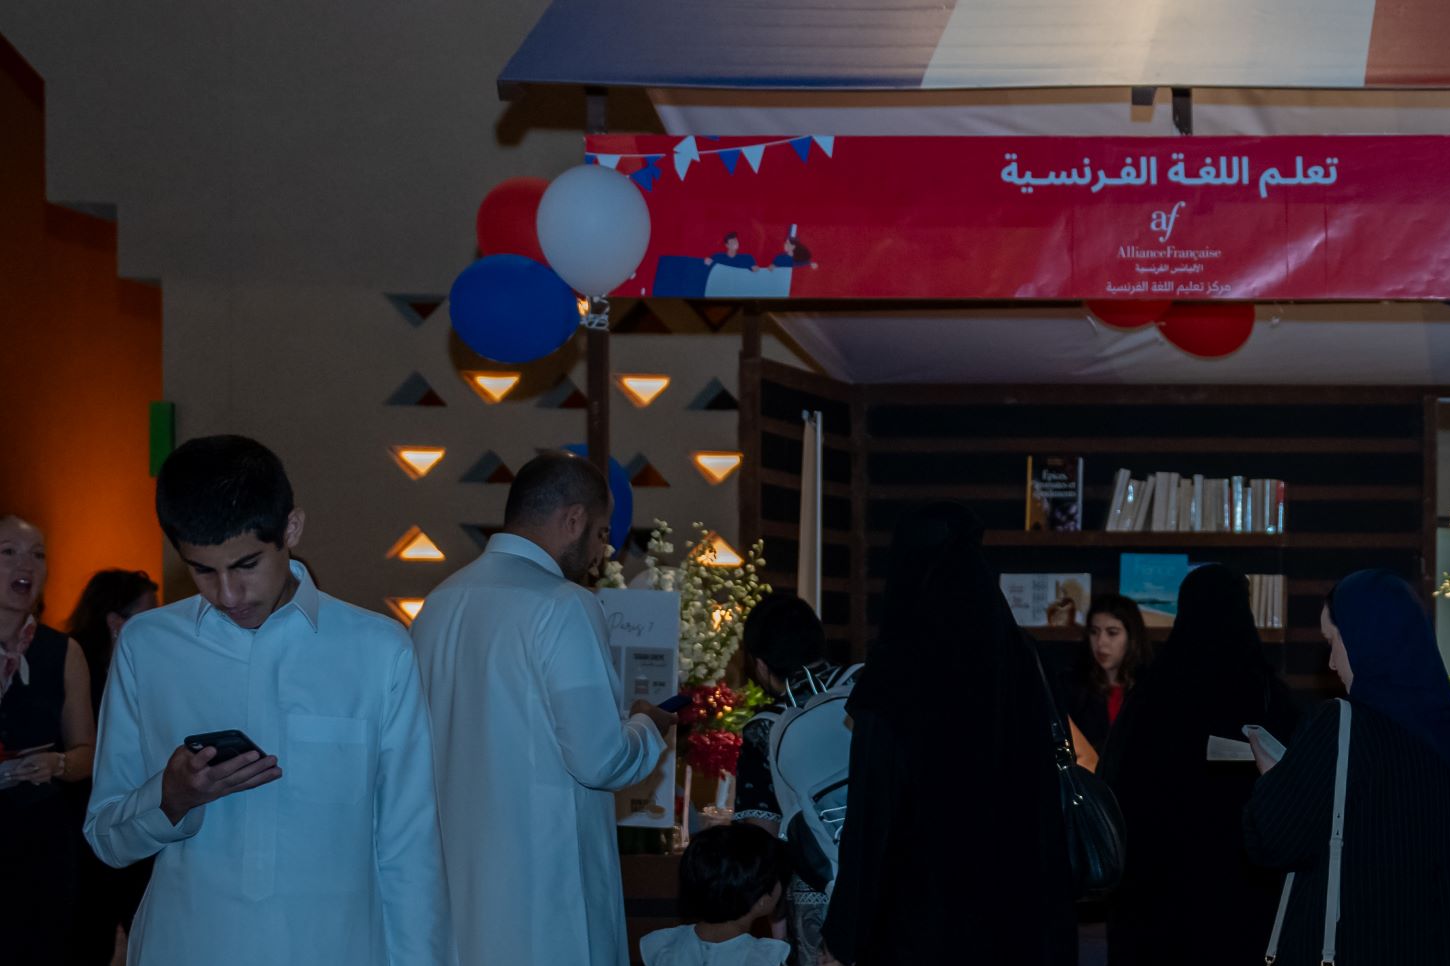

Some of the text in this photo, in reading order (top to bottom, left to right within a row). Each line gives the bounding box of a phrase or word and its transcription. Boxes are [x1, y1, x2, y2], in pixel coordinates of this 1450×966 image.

[1000, 152, 1339, 198] تعلم اللغة الفرنسية
